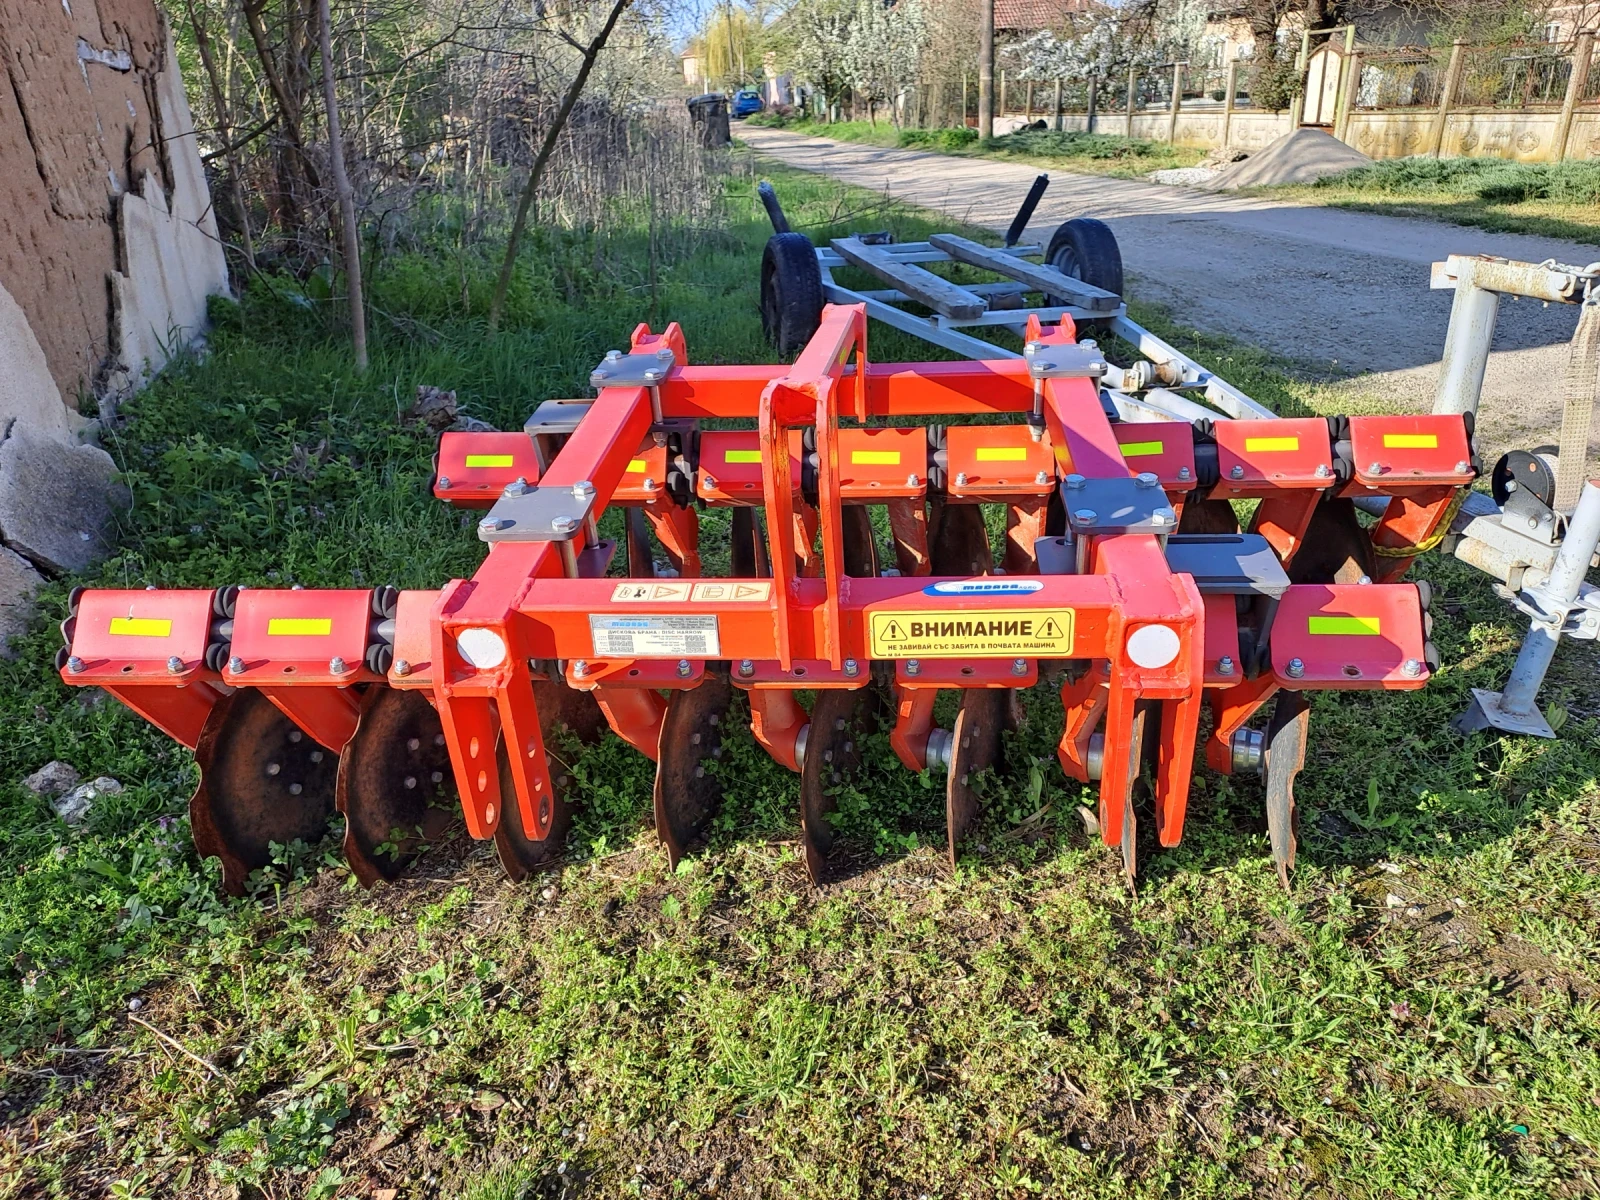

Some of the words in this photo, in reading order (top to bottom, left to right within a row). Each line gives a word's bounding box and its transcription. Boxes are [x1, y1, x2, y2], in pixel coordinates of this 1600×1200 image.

[910, 620, 1033, 638] ВНИМАНИЕ
[898, 642, 932, 651] ЗАВИВАЙ
[987, 642, 1022, 650] ПОЧВАТА
[1023, 641, 1056, 649] МАШИНА
